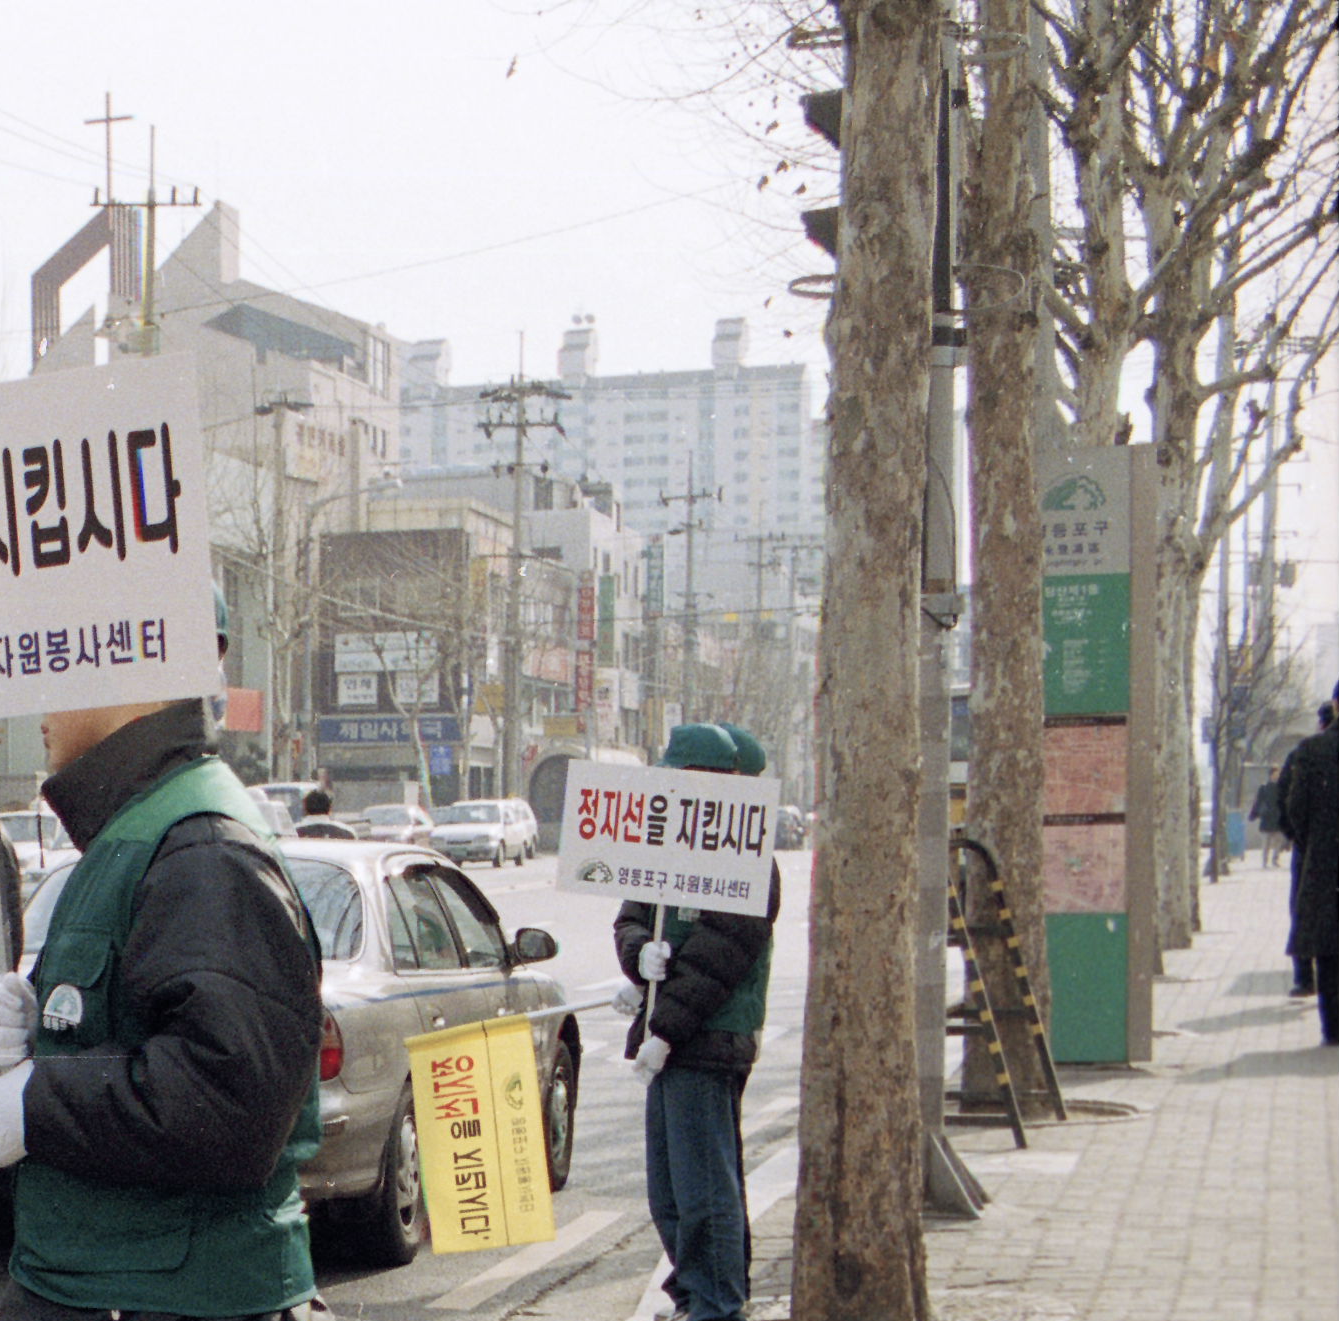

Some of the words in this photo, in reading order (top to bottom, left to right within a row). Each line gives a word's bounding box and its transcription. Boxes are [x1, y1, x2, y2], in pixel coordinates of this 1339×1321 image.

[578, 788, 668, 846] 정지선을
[676, 797, 767, 857] 지킵시다
[618, 866, 668, 888] 영등포구
[673, 872, 751, 900] 자원봉사센터
